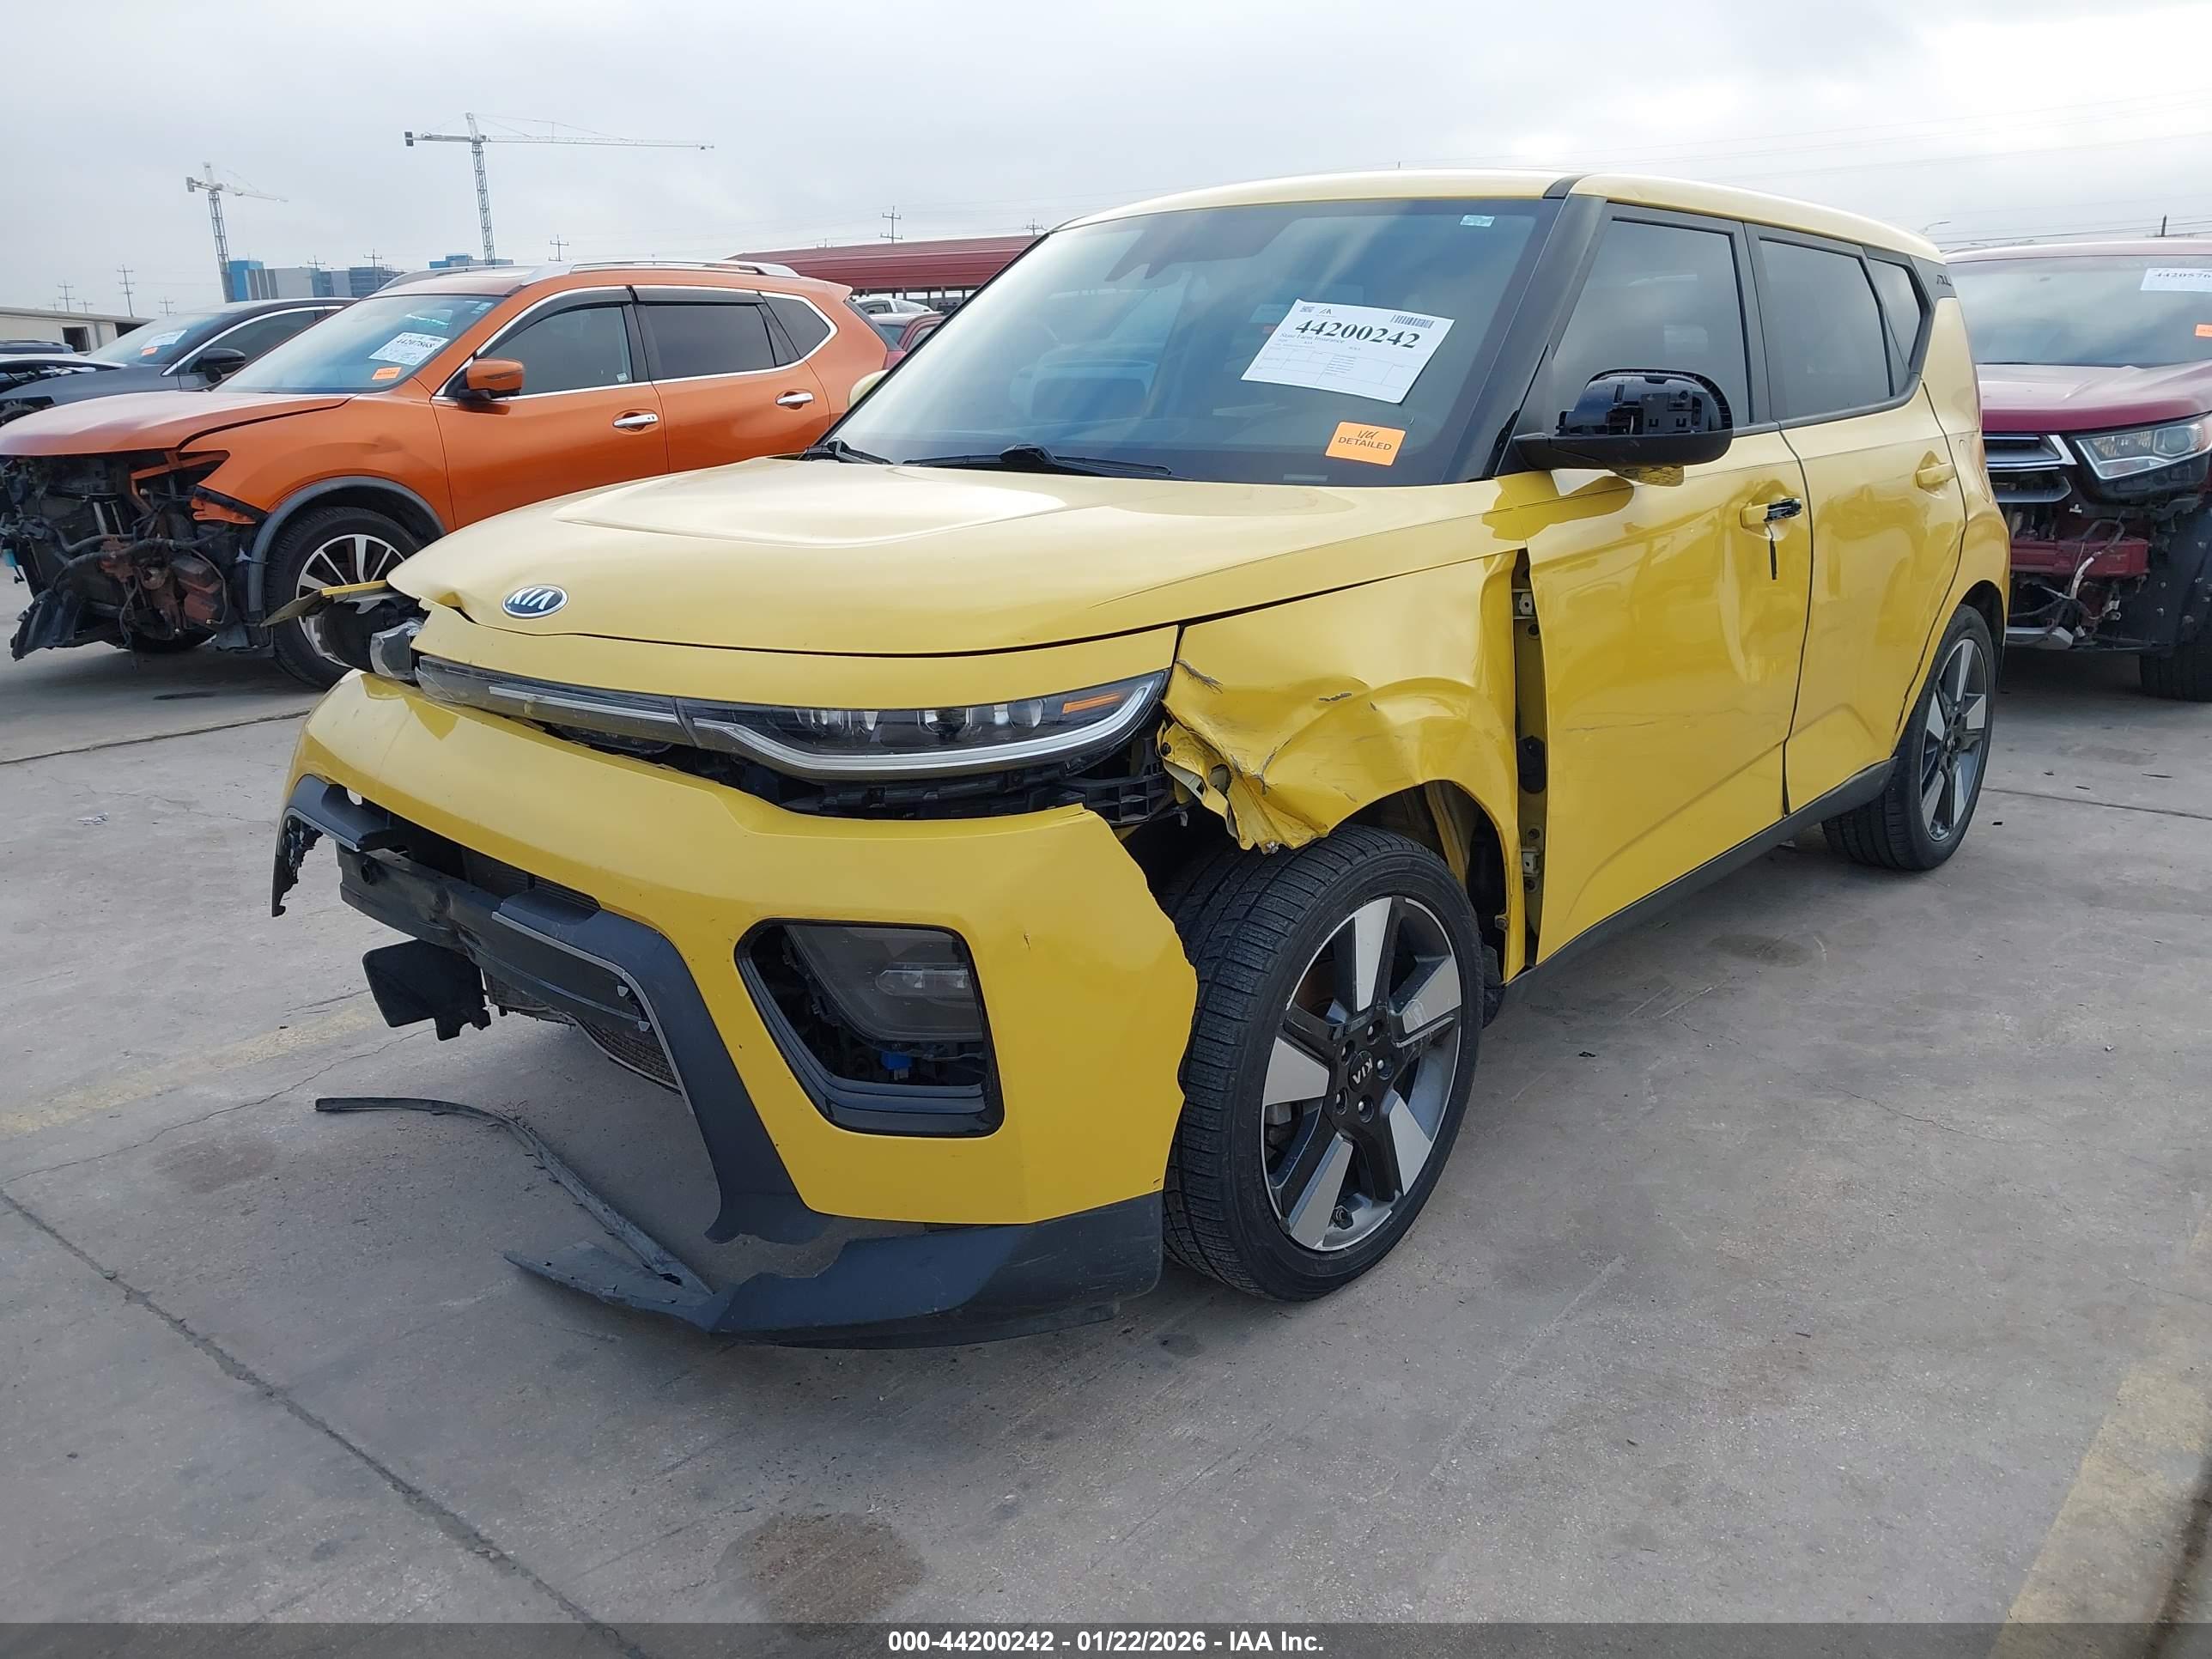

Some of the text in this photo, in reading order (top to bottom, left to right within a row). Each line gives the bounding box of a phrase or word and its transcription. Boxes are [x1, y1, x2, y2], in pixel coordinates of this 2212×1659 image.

[1294, 319, 1421, 349] 44200242
[1338, 436, 1393, 451] DETAILED
[507, 586, 556, 611] KIA
